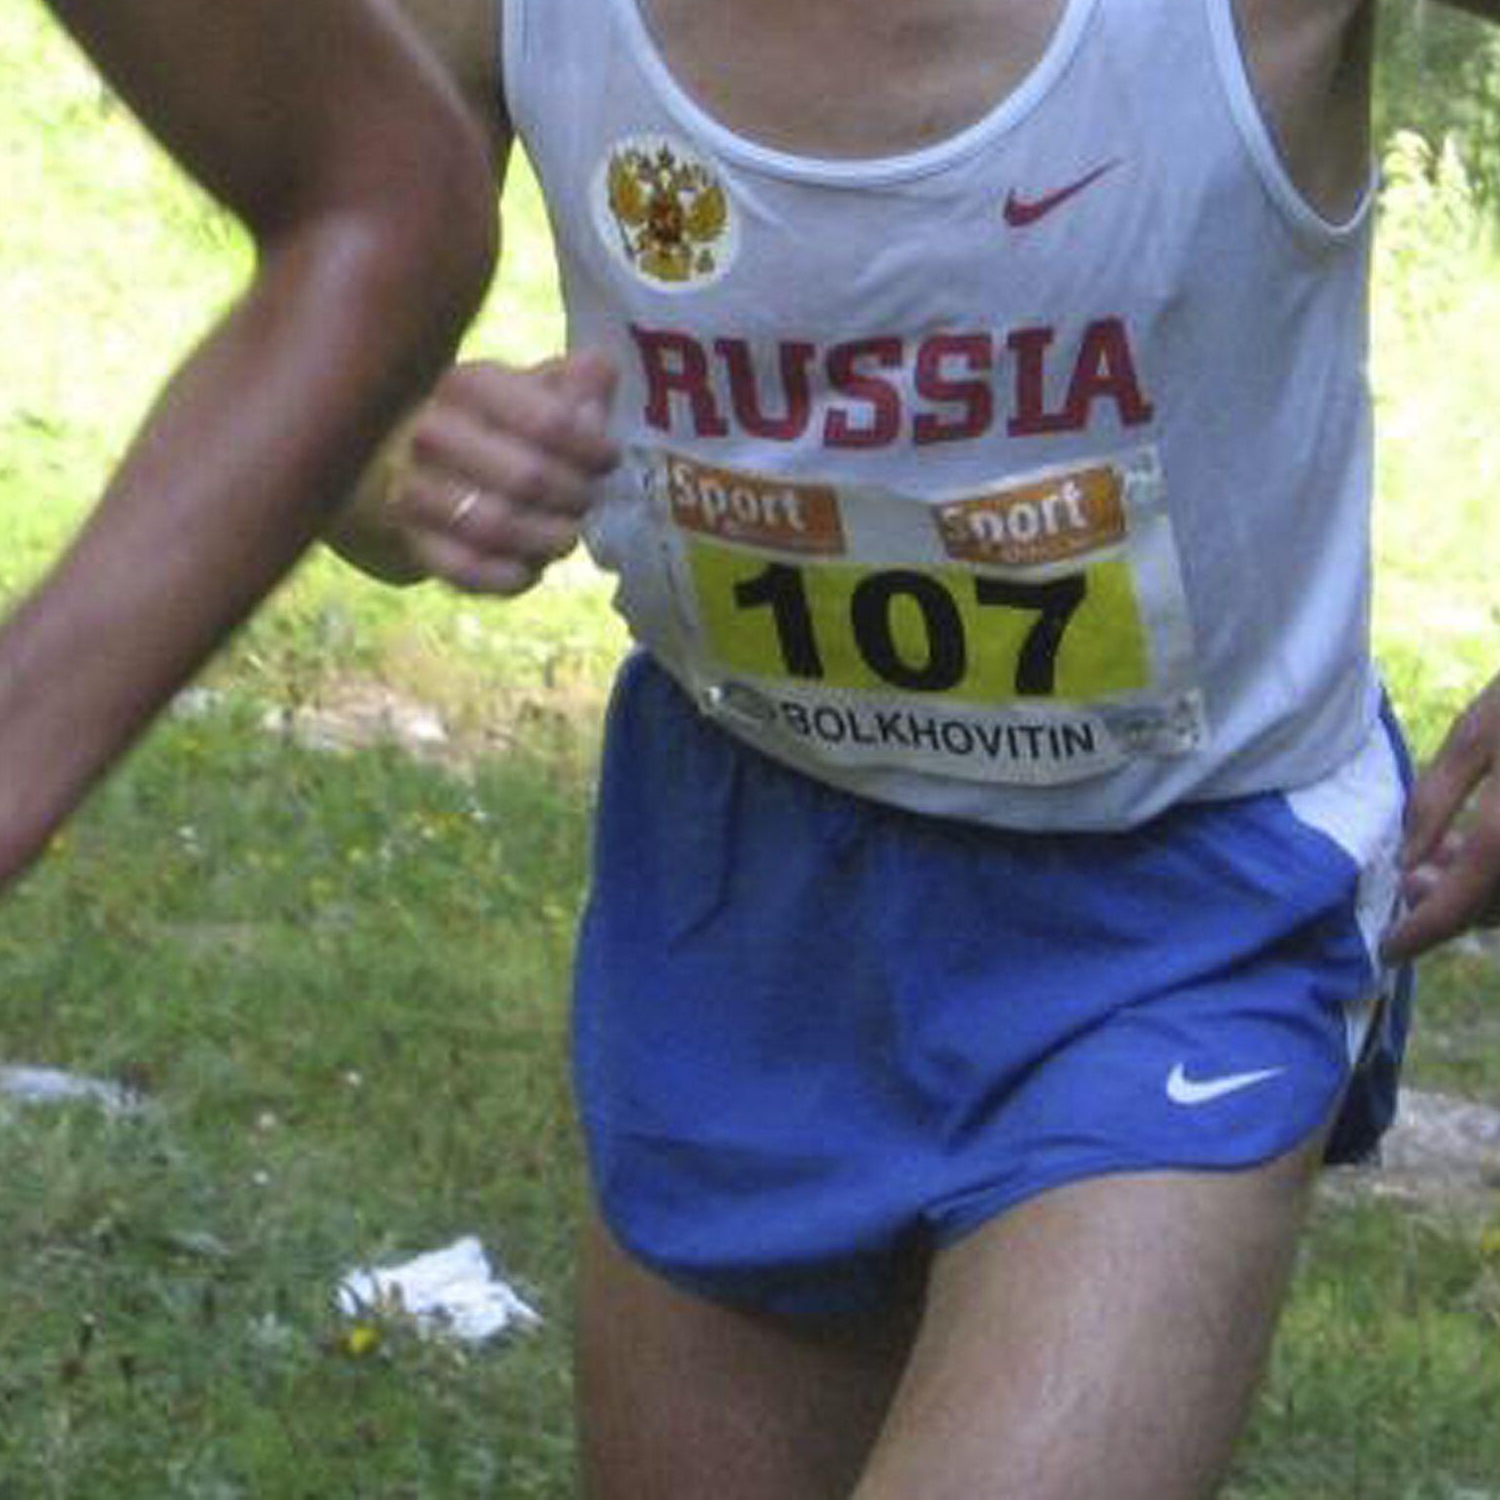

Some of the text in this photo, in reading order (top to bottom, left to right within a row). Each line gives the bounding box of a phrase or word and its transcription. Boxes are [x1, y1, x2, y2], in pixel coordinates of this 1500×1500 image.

[629, 316, 1154, 450] RUSSIA
[733, 561, 1087, 696] 107
[779, 702, 1096, 760] BOLKHOVITIN
